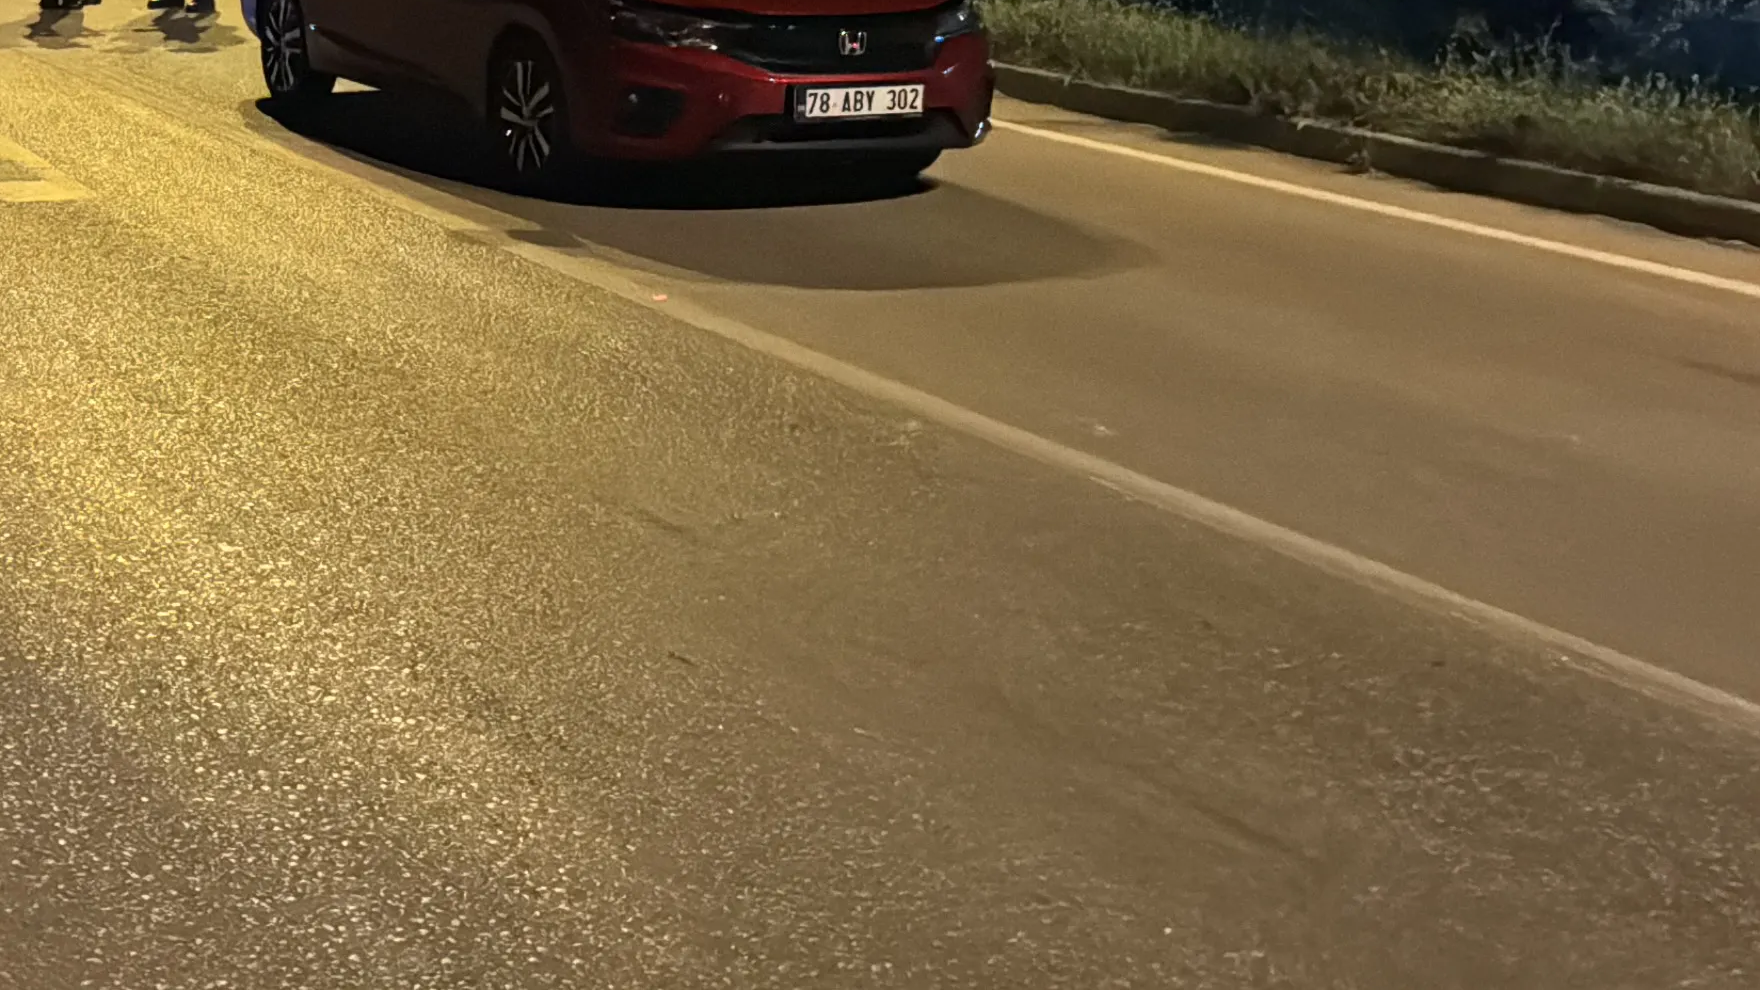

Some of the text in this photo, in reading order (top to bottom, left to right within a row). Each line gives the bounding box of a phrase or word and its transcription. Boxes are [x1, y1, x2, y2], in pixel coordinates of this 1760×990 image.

[808, 88, 919, 115] 78 ABY 302
